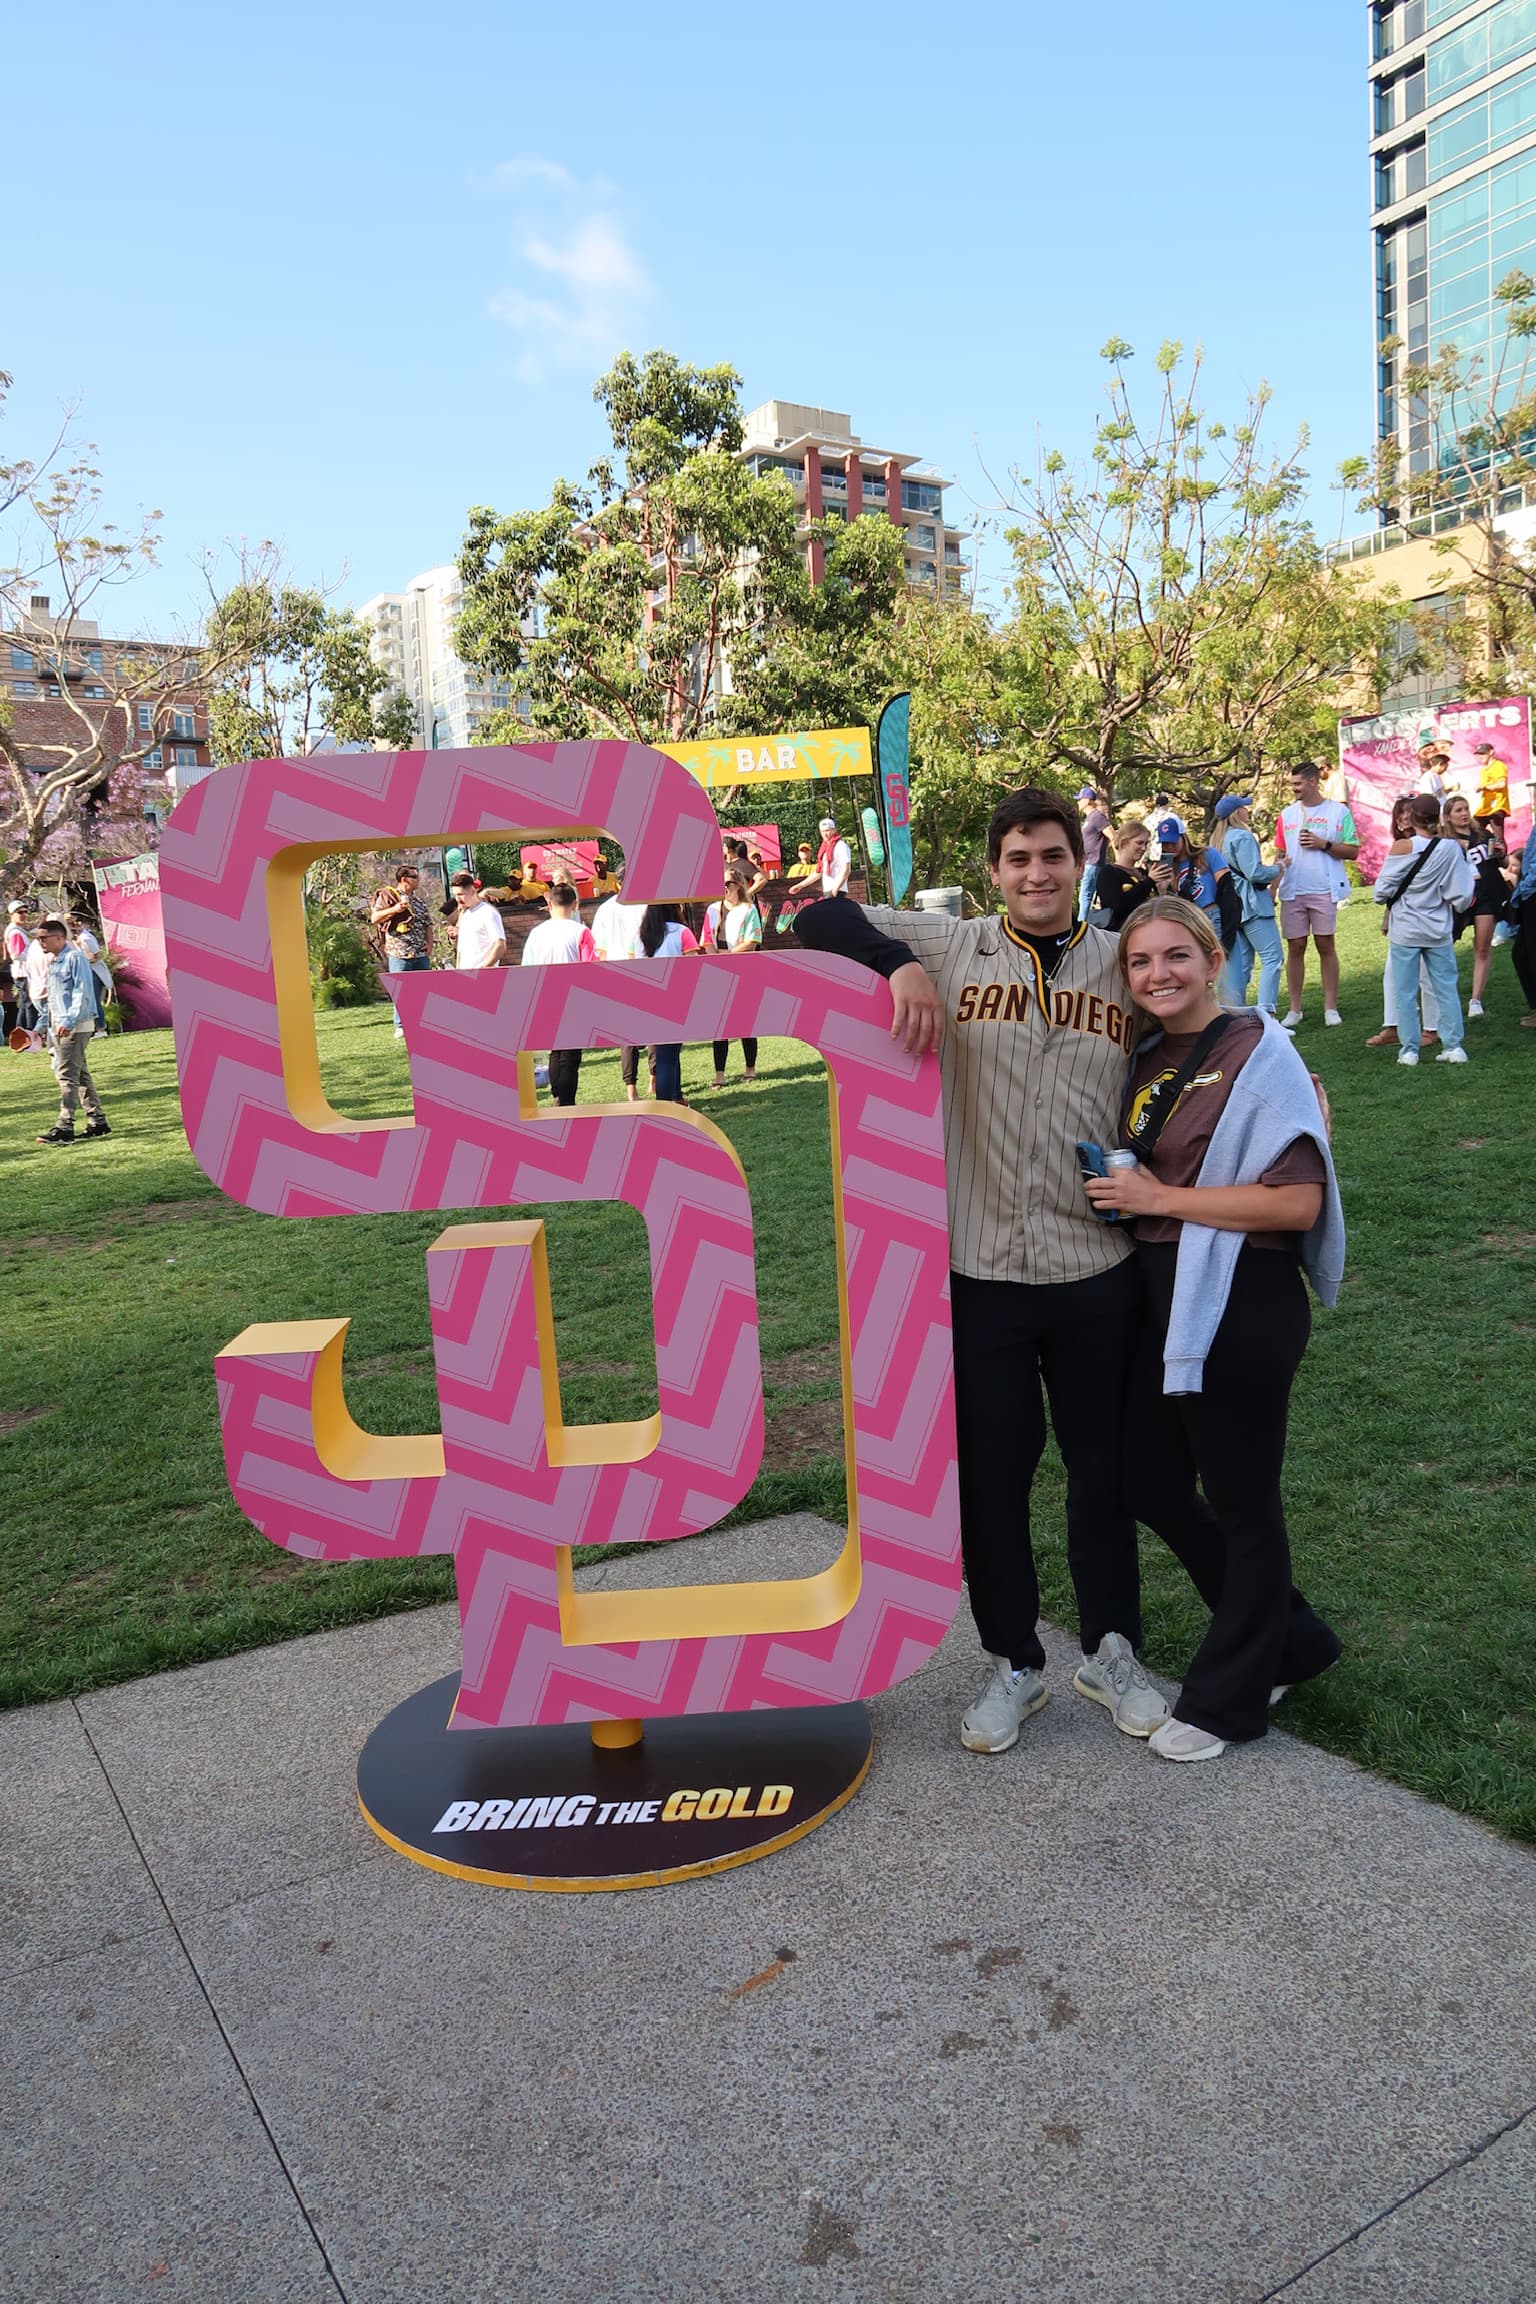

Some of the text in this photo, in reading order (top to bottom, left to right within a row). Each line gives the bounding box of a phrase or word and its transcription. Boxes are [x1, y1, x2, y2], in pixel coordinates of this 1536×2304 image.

[736, 745, 797, 773] BAR
[956, 983, 1135, 1056] SAN DIEGO
[432, 1784, 794, 1833] BRING THE GOLD
